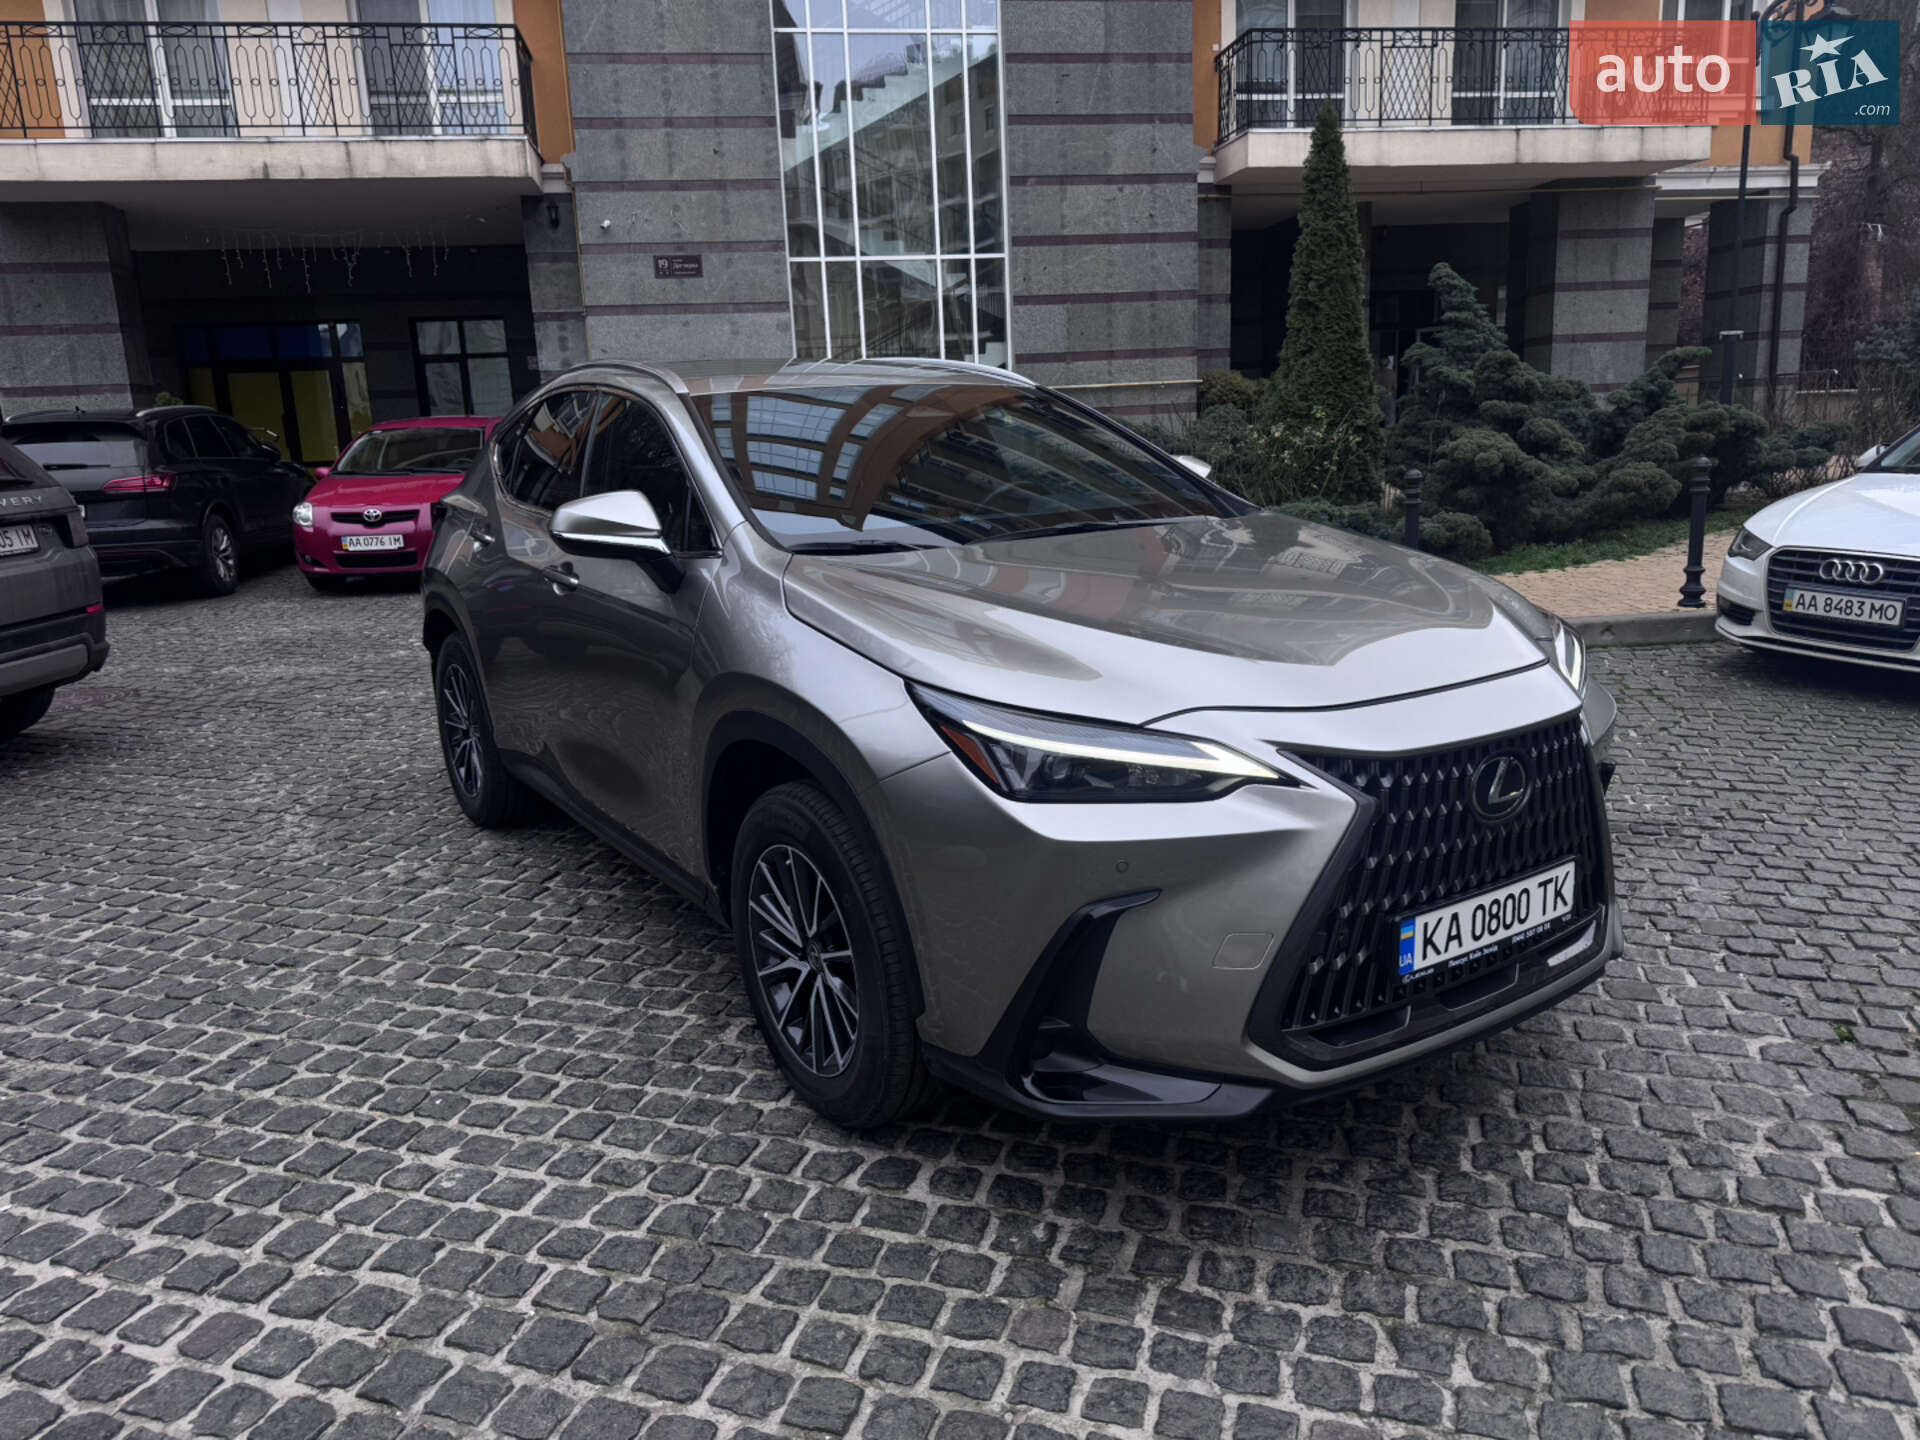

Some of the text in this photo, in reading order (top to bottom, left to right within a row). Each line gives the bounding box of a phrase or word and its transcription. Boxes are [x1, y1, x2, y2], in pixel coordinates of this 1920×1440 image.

[348, 536, 401, 547] AA 0776 IM
[1795, 593, 1897, 620] AA 8483 MO
[1422, 911, 1463, 961] KA
[1471, 888, 1530, 941] 0800
[1538, 870, 1571, 917] TK
[1400, 952, 1413, 967] UA
